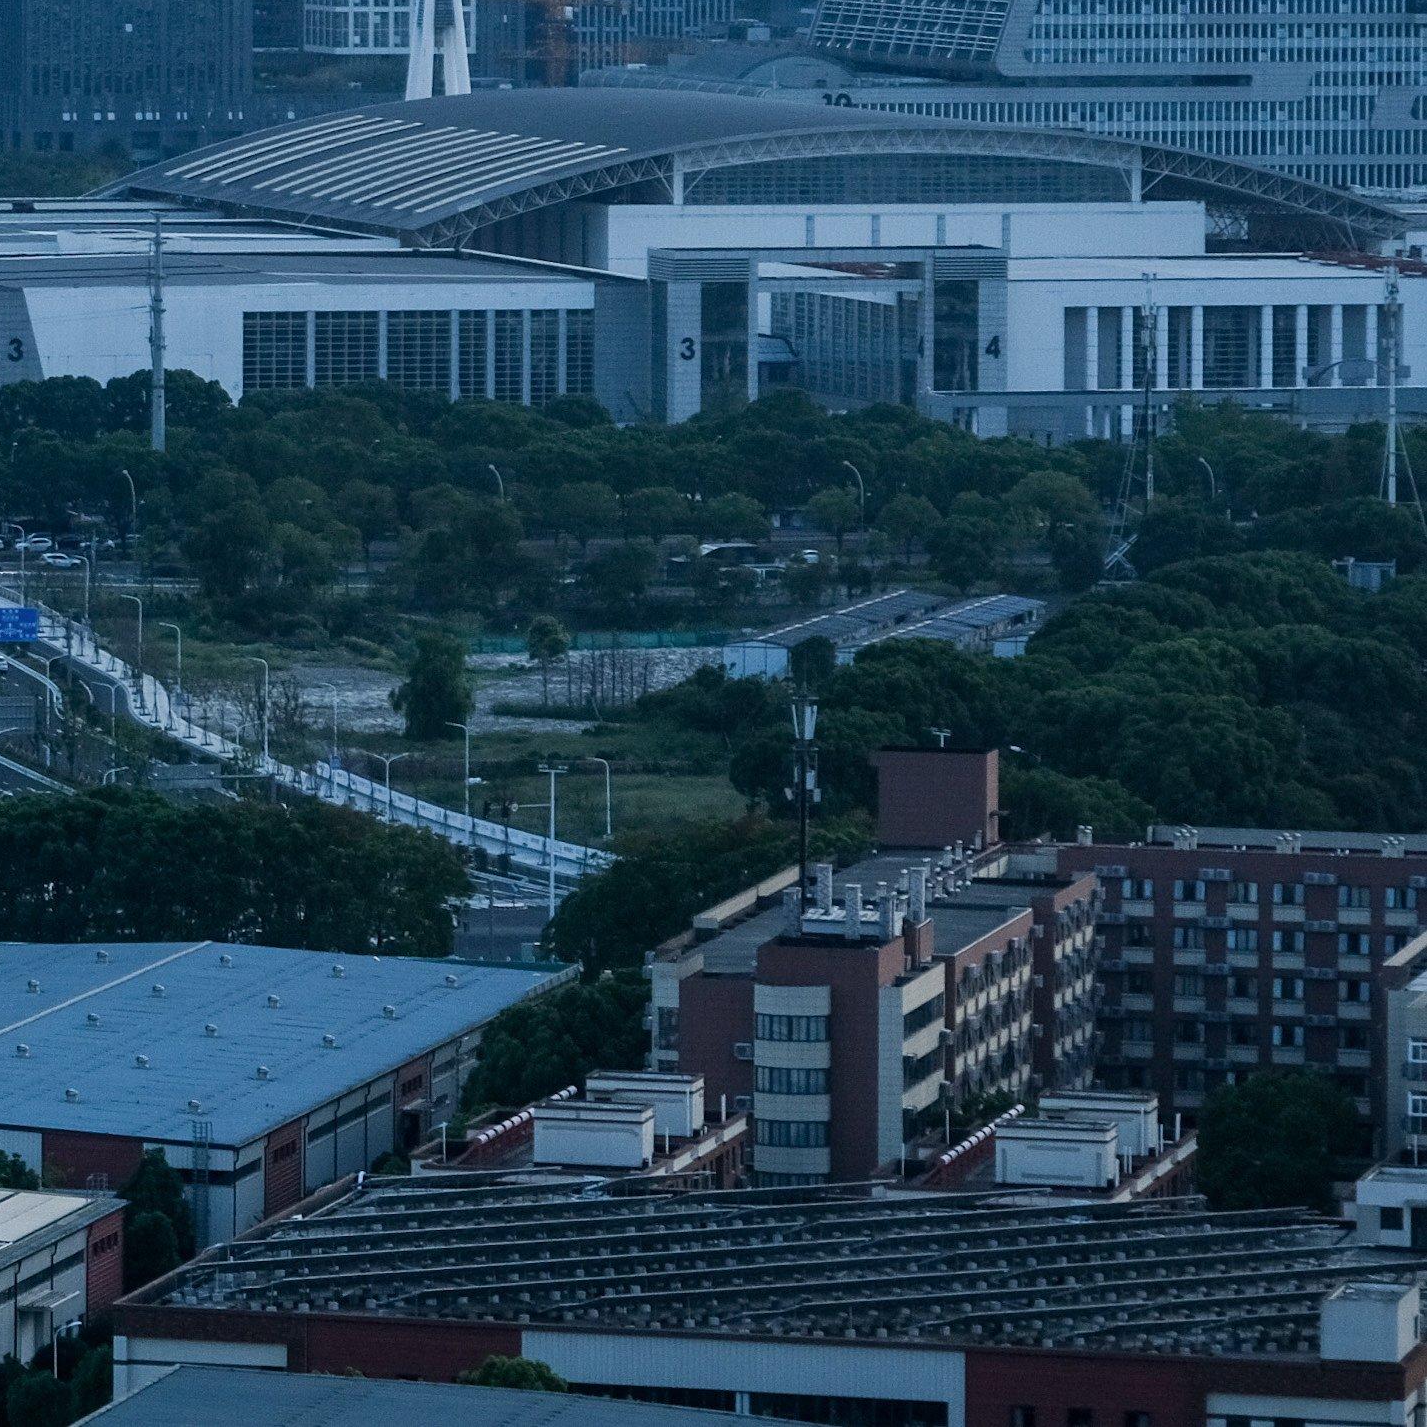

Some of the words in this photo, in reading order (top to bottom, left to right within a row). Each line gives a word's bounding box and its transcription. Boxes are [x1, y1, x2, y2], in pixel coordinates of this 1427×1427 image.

[7, 337, 24, 363] 3
[680, 337, 696, 361] 3
[985, 335, 1001, 359] 4
